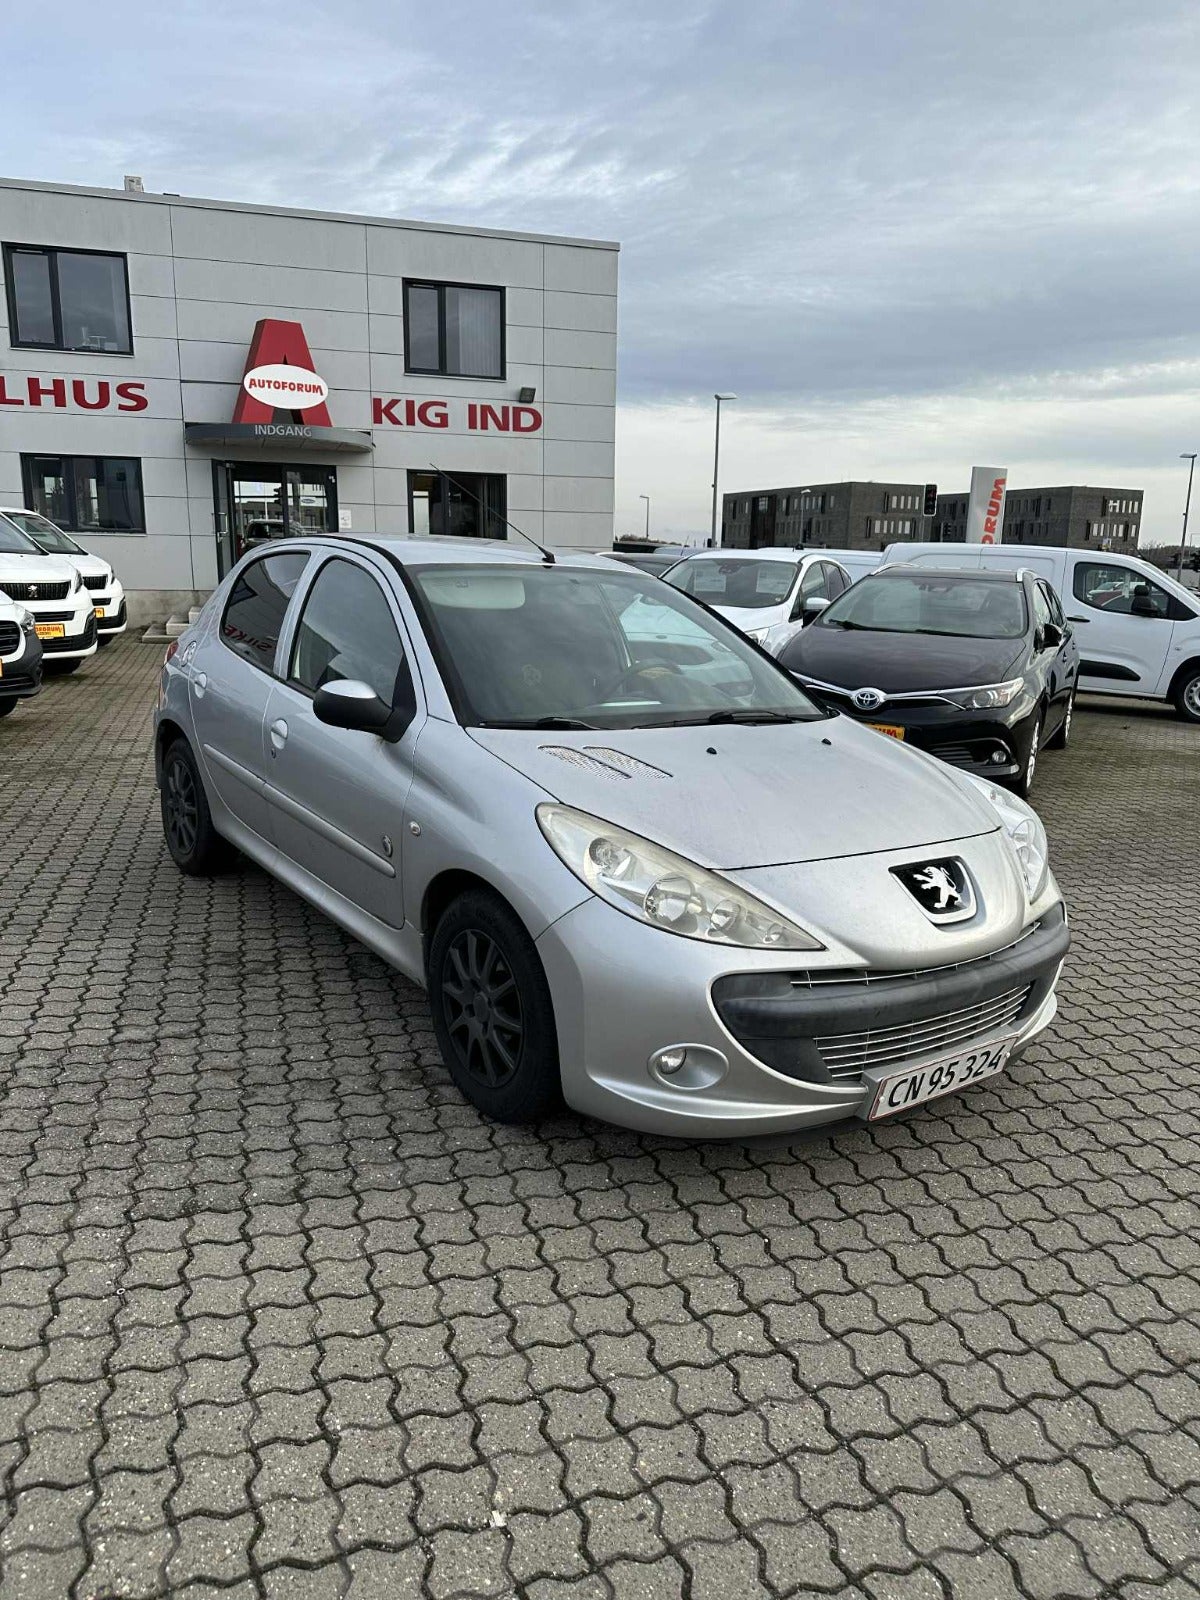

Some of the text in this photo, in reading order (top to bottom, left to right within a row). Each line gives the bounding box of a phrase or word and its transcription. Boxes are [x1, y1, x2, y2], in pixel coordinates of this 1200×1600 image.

[248, 378, 324, 396] AUTOFORUM
[372, 397, 543, 433] KIG IND
[254, 424, 312, 437] INDGANG
[888, 1044, 1006, 1107] CN 95 324
